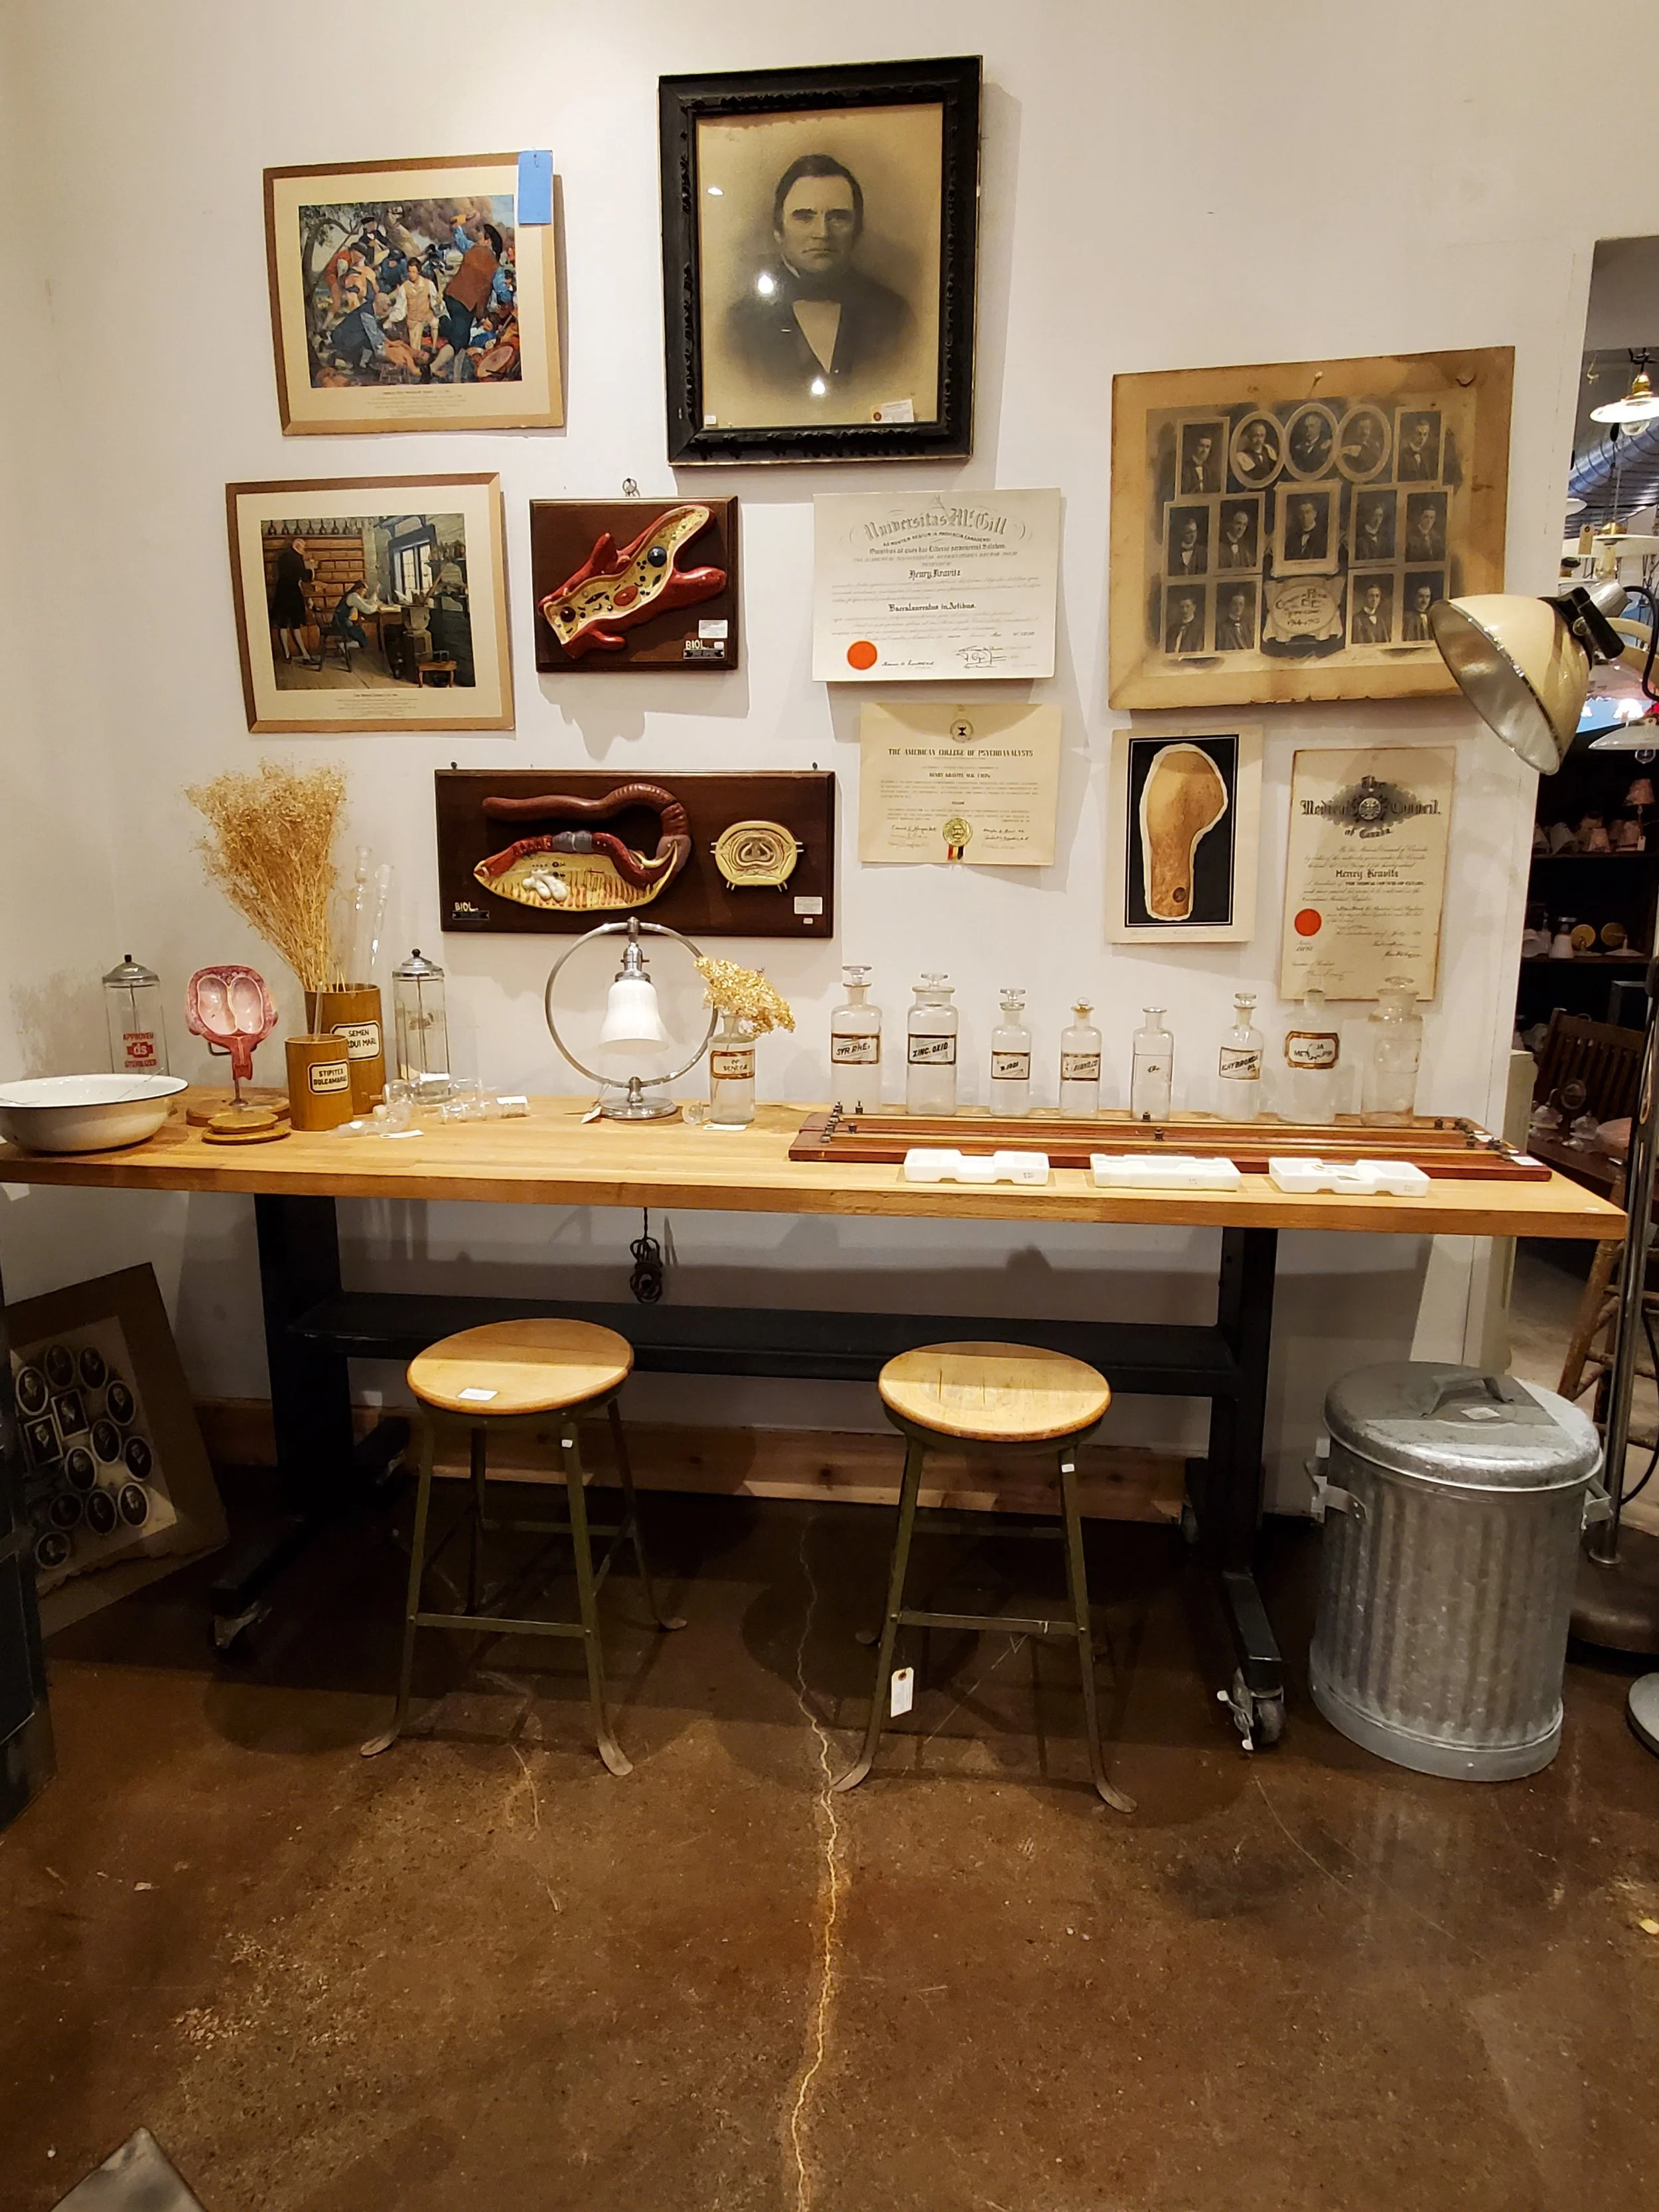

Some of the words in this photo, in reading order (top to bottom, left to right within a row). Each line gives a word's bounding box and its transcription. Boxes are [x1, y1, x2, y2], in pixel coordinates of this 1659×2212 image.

[864, 512, 947, 541] Universitas
[908, 569, 932, 581] Henry
[939, 748, 965, 757] COLLEGE
[1336, 869, 1363, 881] Henry
[348, 1029, 370, 1037] SEMEN
[319, 1068, 344, 1077] STIPITES
